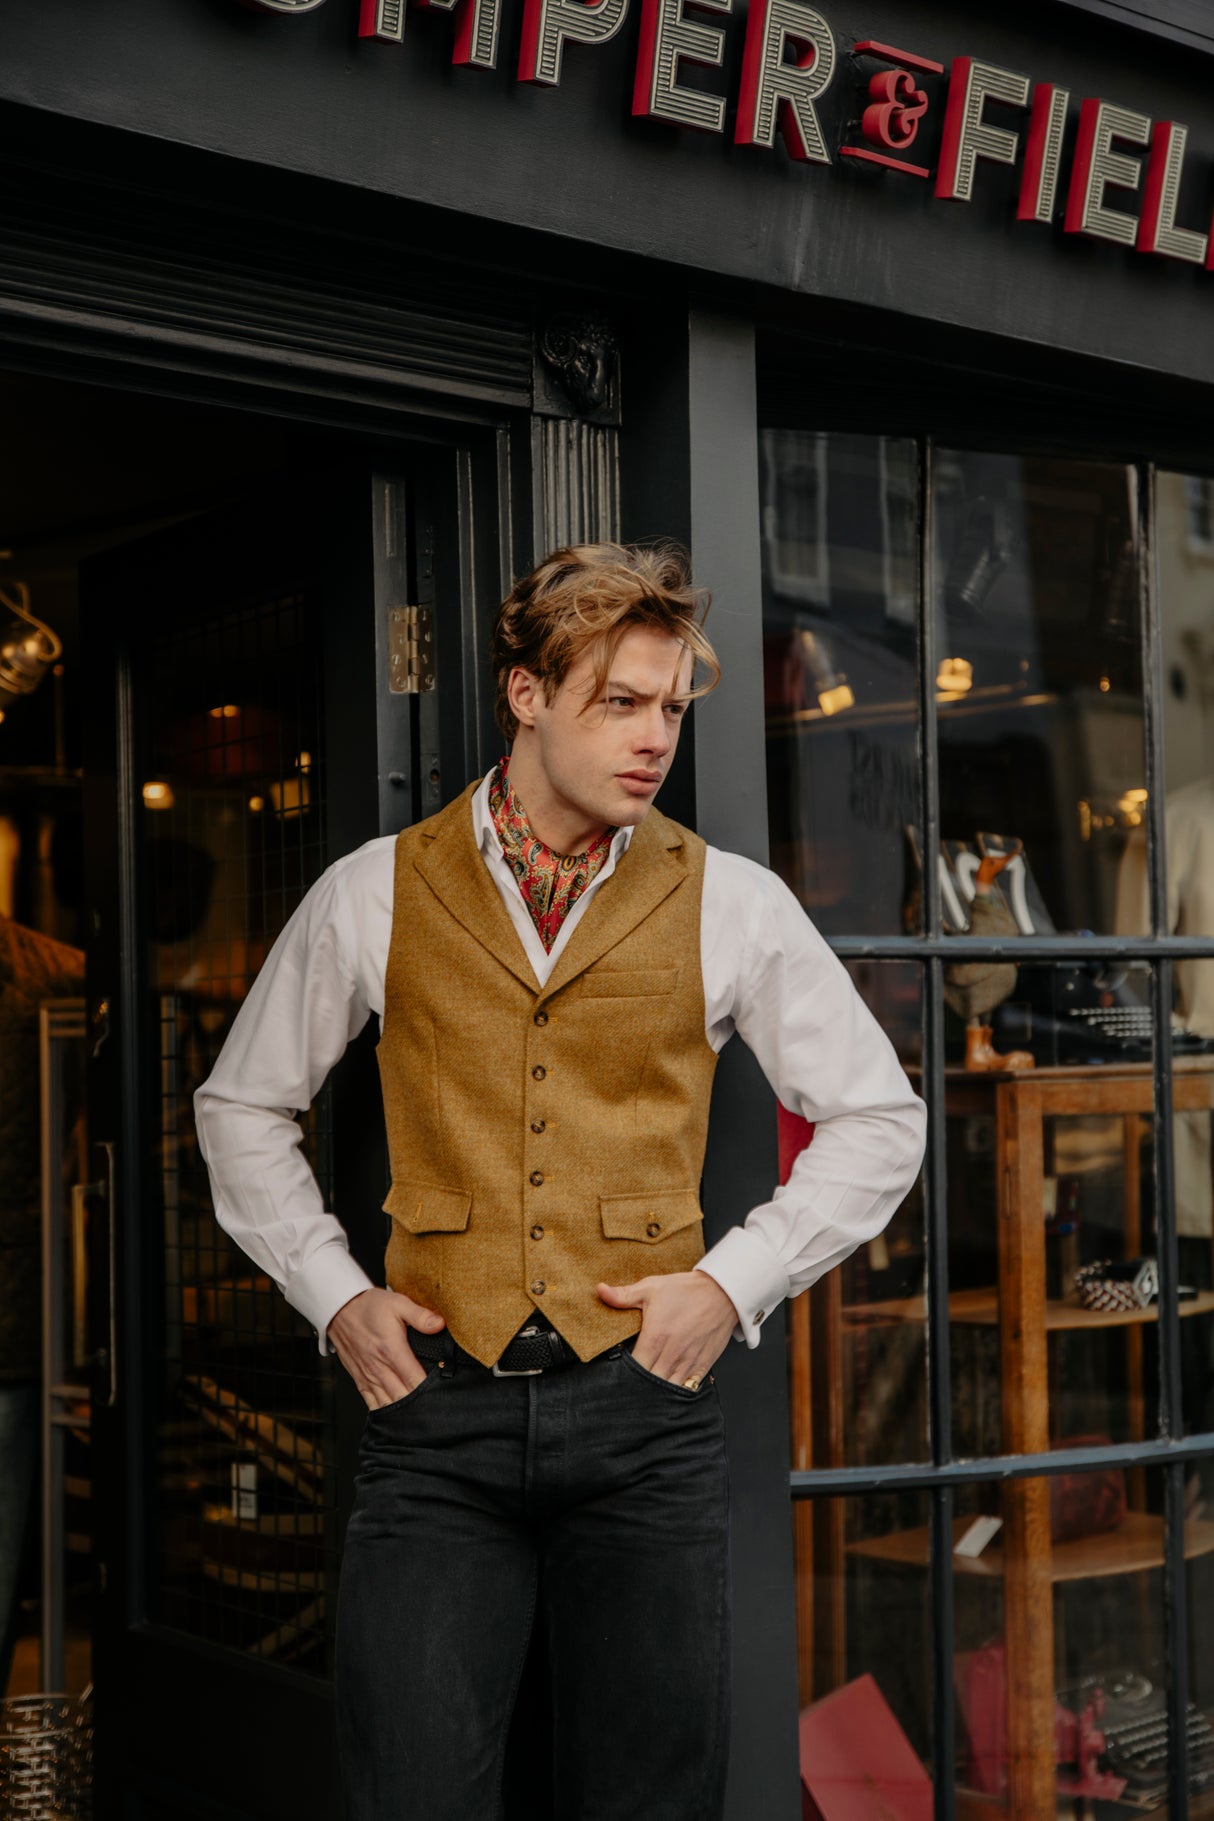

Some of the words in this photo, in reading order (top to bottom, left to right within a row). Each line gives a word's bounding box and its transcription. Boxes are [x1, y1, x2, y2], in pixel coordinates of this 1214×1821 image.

[241, 0, 837, 166] PER
[862, 69, 929, 150] &
[934, 56, 1214, 271] FIEL
